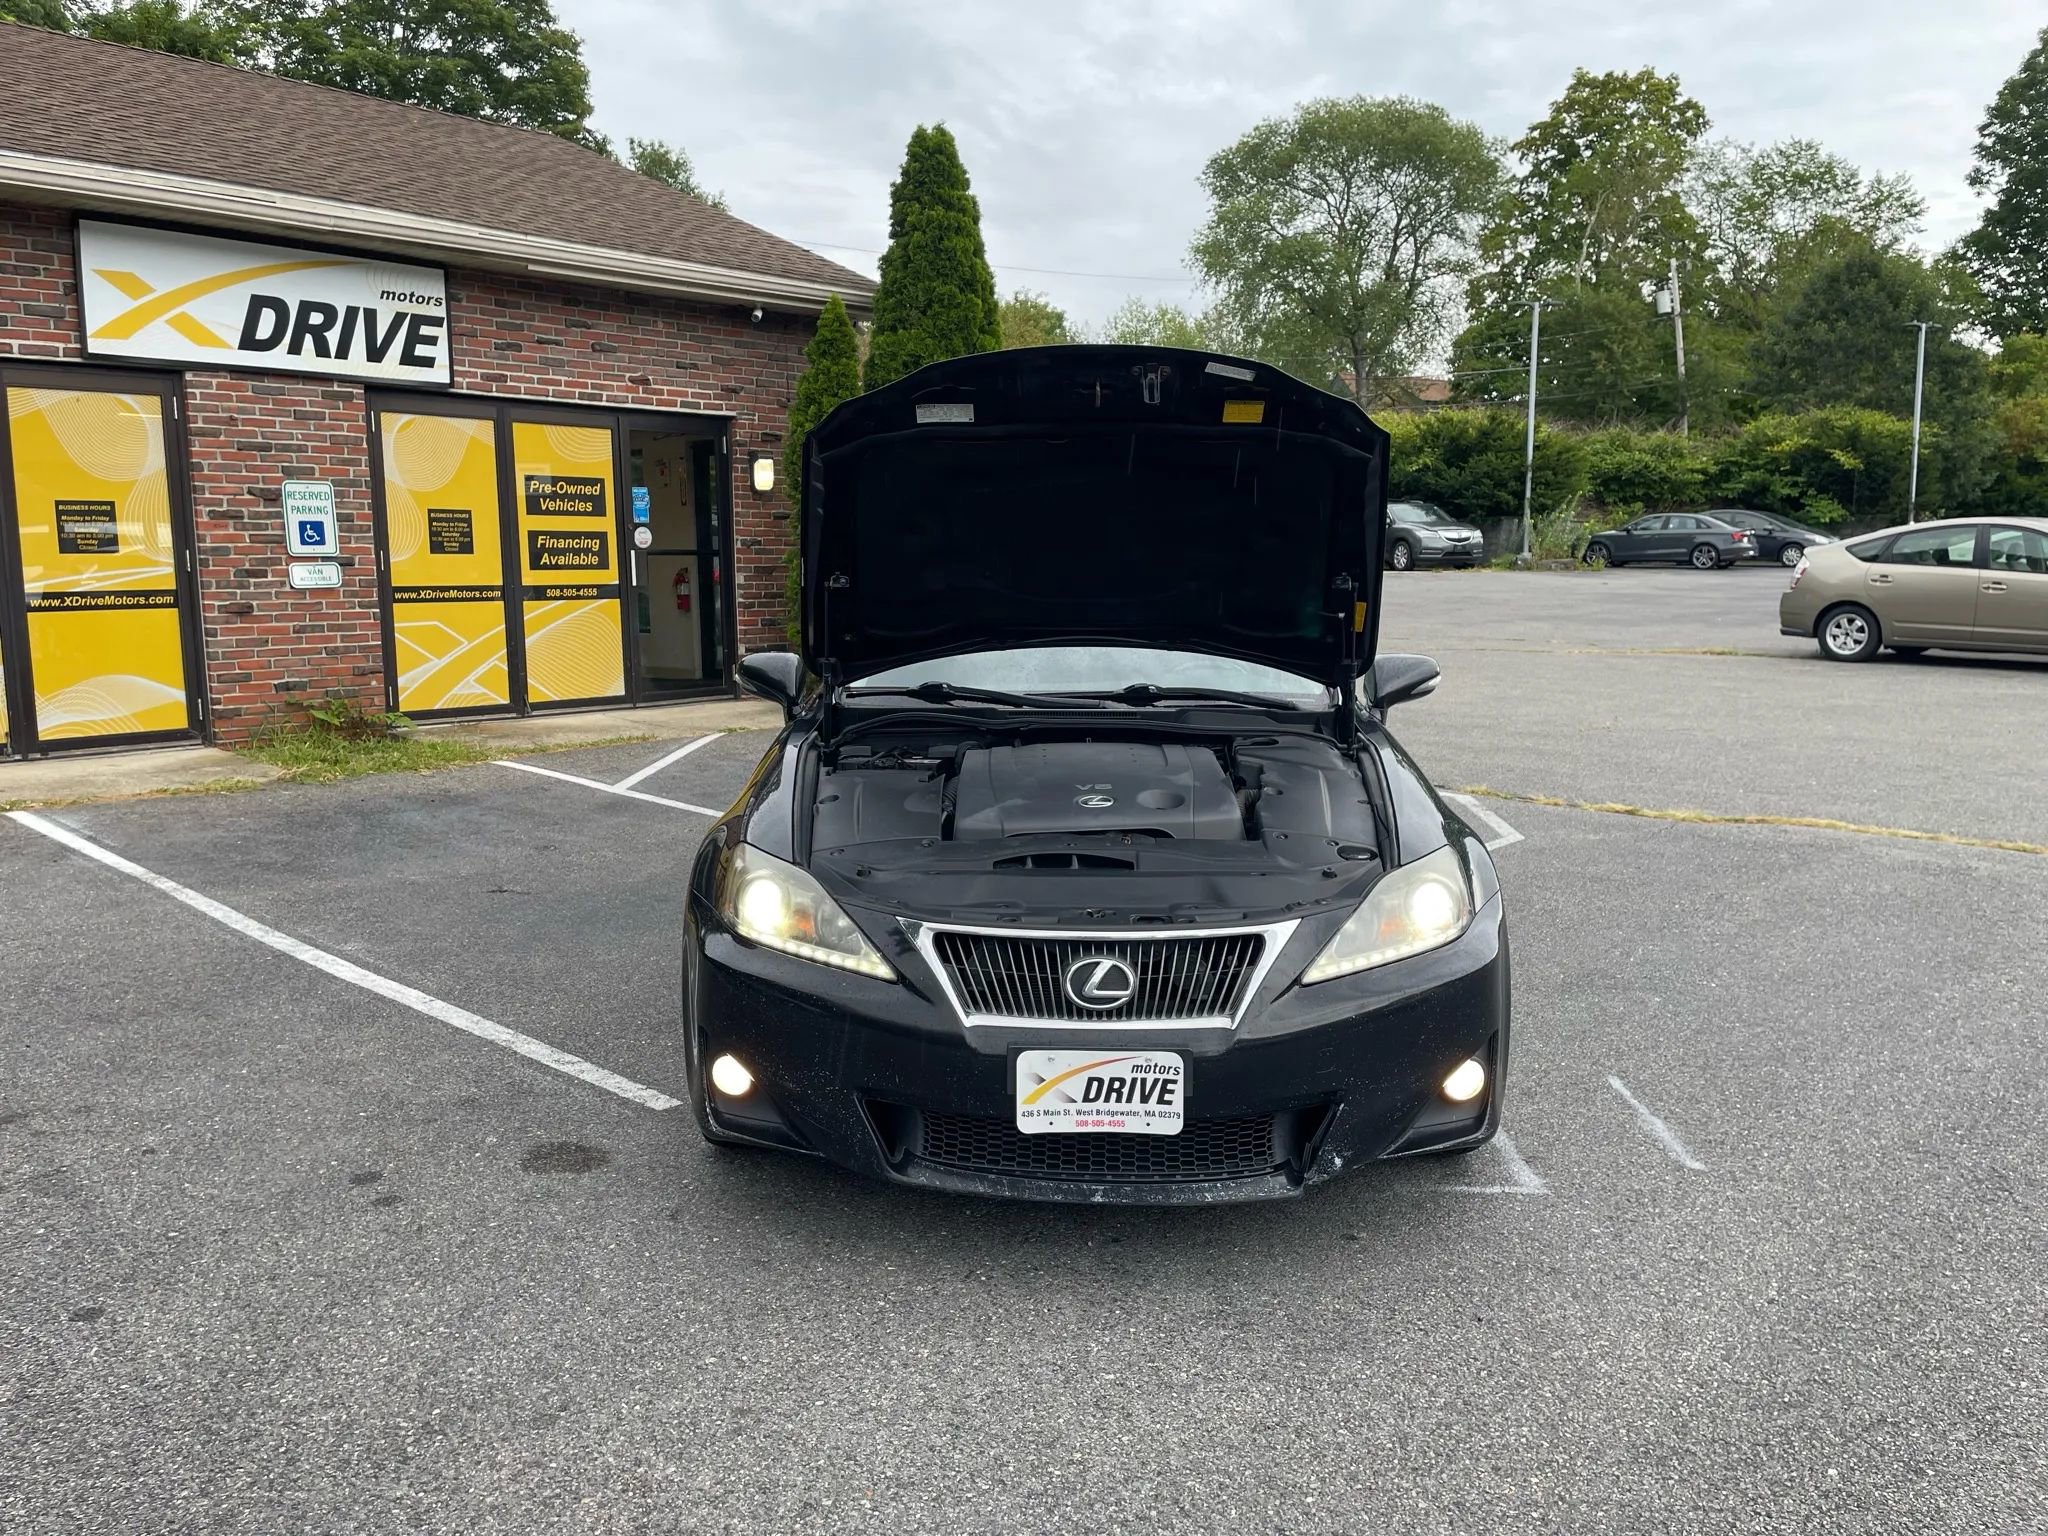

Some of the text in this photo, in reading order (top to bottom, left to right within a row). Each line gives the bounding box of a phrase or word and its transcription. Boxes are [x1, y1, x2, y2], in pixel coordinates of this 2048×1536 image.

[380, 289, 444, 308] motors
[237, 294, 446, 369] DRIVE
[530, 481, 600, 495] Pre-Owned
[287, 491, 330, 501] RESERVED
[291, 506, 329, 515] PARKING
[540, 498, 593, 511] Vehicles
[537, 536, 600, 551] Financing
[540, 553, 599, 565] Available
[394, 589, 502, 600] www.XDriveMotors.com
[546, 588, 598, 597] 508-505-4555
[30, 595, 174, 607] www.XDriveMotors.com
[1131, 1062, 1181, 1076] motors
[1082, 1077, 1178, 1105] DRIVE
[1021, 1109, 1181, 1119] 436 S Main St. West Bridgewater, MA 02379
[1075, 1120, 1126, 1128] 508-505-4555
